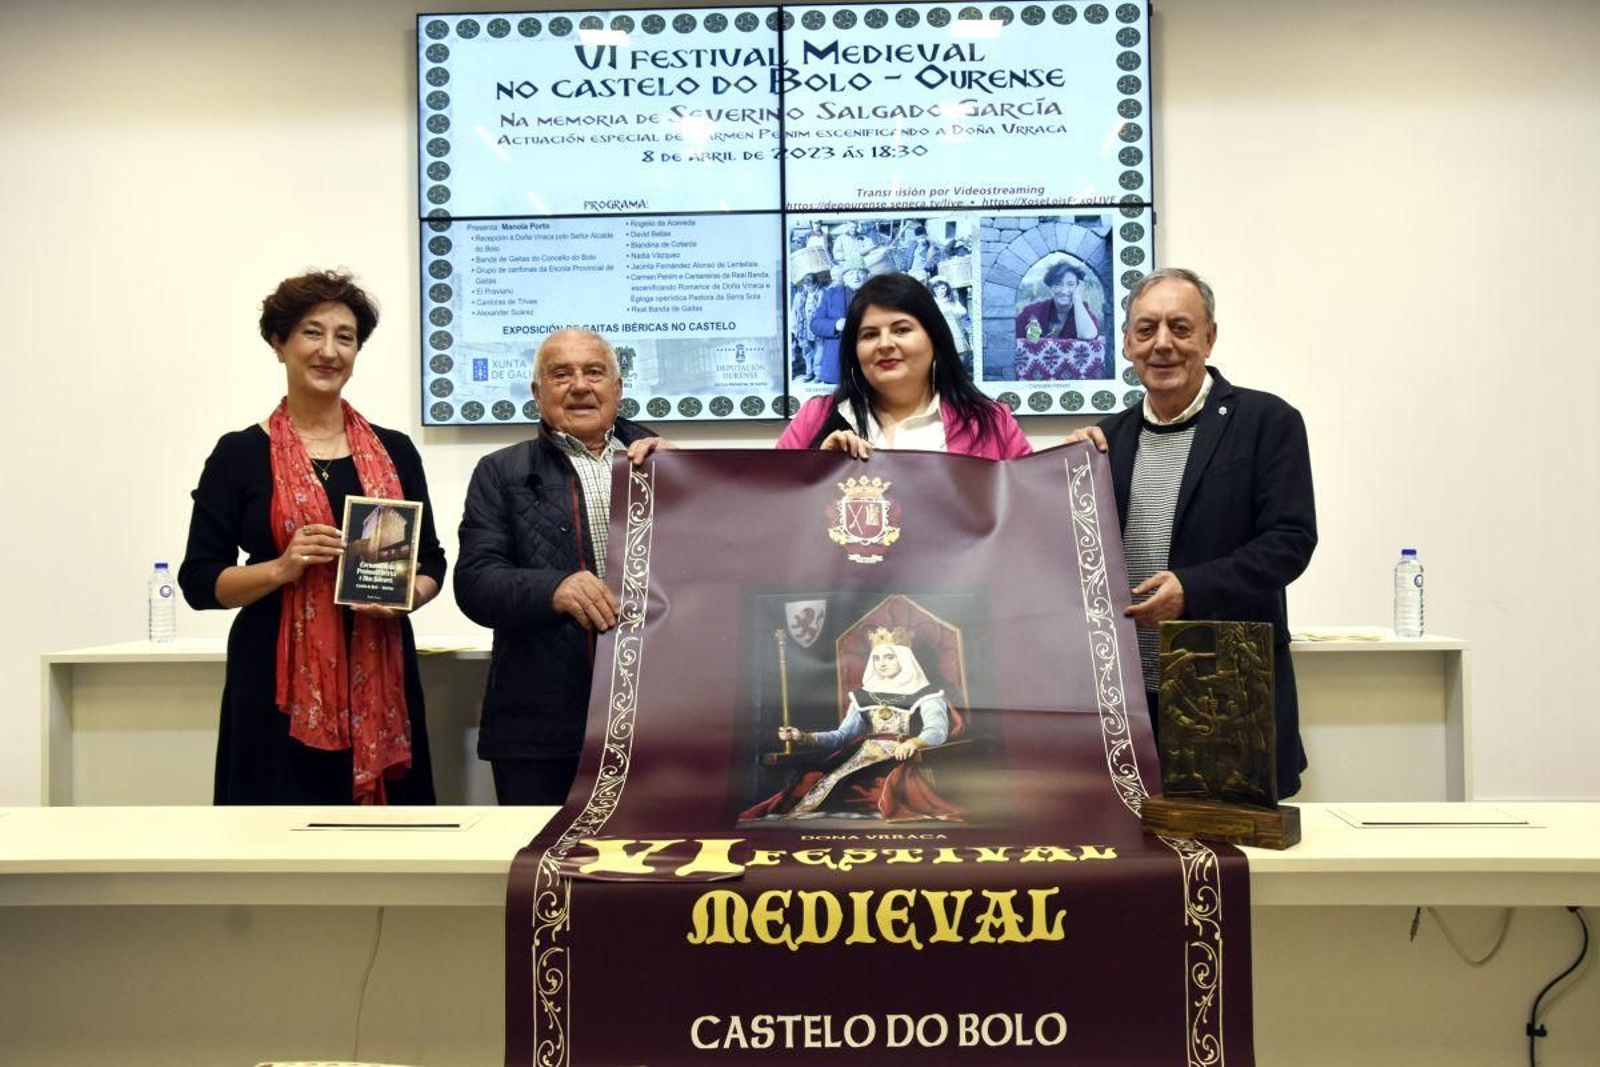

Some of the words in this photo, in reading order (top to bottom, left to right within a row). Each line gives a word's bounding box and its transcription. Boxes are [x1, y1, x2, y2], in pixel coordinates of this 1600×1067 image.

[574, 45, 617, 70] VI
[631, 47, 788, 70] FESTIVAL
[803, 39, 985, 65] MEDIEVAL
[496, 80, 539, 100] NO
[551, 76, 700, 98] CASTELO
[713, 75, 758, 94] DO
[770, 67, 872, 94] BOLO
[915, 64, 1066, 93] OURENSE
[500, 113, 530, 127] NA
[537, 113, 629, 127] MEMORIA
[636, 113, 660, 125] DE
[959, 97, 1063, 119] GARCÍA
[497, 133, 585, 146] ACTUACIÓN
[590, 133, 659, 143] ESPECIAL
[665, 133, 683, 142] DE
[935, 127, 946, 136] A
[952, 124, 996, 136] DOÑA
[641, 150, 655, 163] 8
[661, 152, 682, 162] DE
[688, 151, 736, 163] ABRIL
[743, 151, 764, 161] DE
[771, 147, 836, 160] 2023
[872, 144, 929, 159] 18:30
[929, 188, 949, 198] por
[953, 185, 1045, 196] Videostreaming
[583, 199, 649, 212] PROGRAMA:
[501, 222, 528, 230] Manola
[530, 222, 550, 230] Porto
[630, 219, 656, 228] Rogelio
[630, 230, 650, 238] David
[652, 251, 680, 260] Vázquez
[476, 267, 496, 275] Grupo
[630, 273, 656, 281] Carmen
[726, 292, 745, 300] Serra
[681, 304, 703, 312] Gaitas
[621, 321, 669, 333] IBÉRICAS
[671, 322, 687, 332] NO
[689, 321, 736, 332] CASTELO
[492, 359, 527, 369] XUNTA
[491, 370, 505, 379] DE
[507, 369, 531, 379] GALI
[578, 838, 746, 877] VI
[746, 845, 1118, 871] FESTIVAL
[687, 886, 1067, 951] MEDIEVAL
[691, 1014, 876, 1049] CASTELO
[886, 1013, 949, 1048] DO
[958, 1012, 1068, 1048] BOLO
